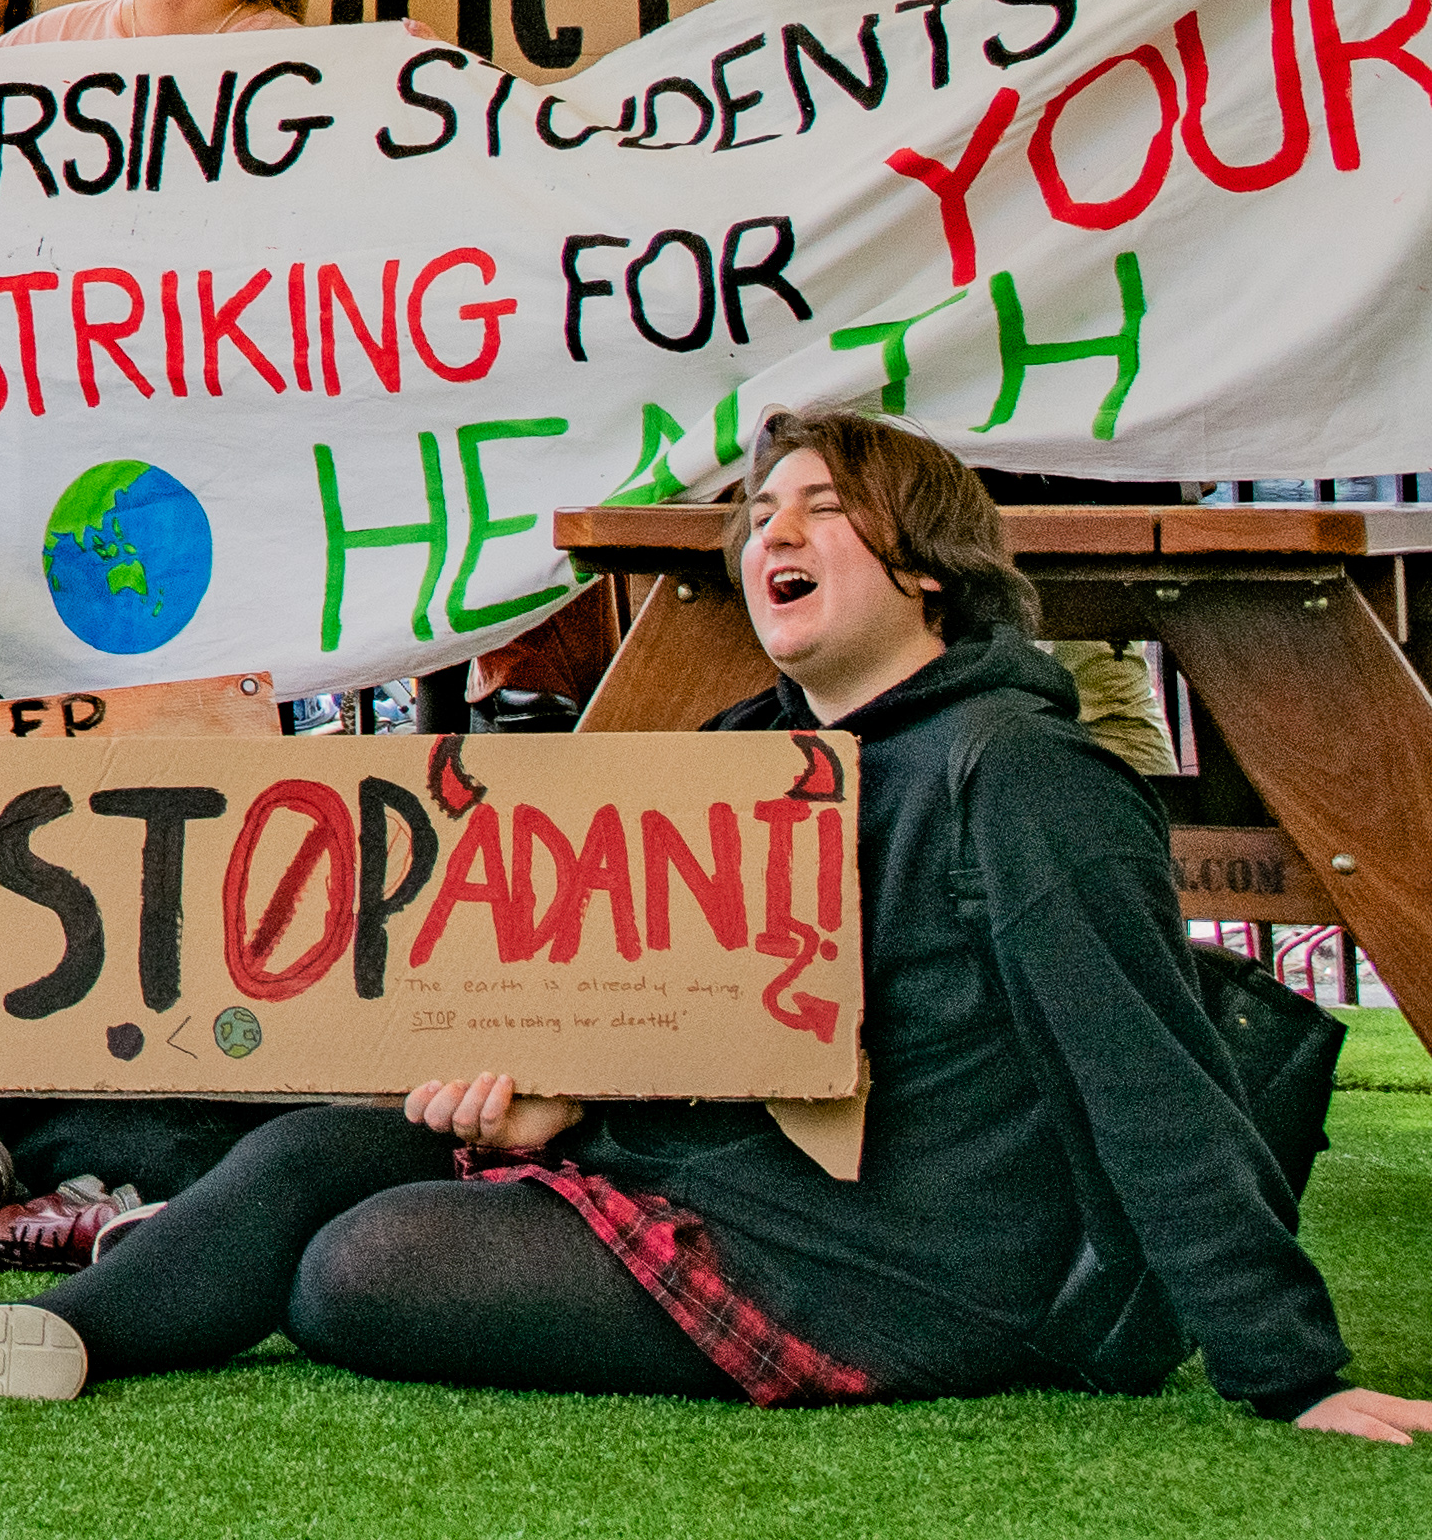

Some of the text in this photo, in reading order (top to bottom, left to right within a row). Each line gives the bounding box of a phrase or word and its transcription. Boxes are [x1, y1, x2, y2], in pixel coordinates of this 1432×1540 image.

[563, 215, 814, 364] FOR
[463, 976, 668, 997] earth is already
[412, 1010, 599, 1033] STOP accelerating her
